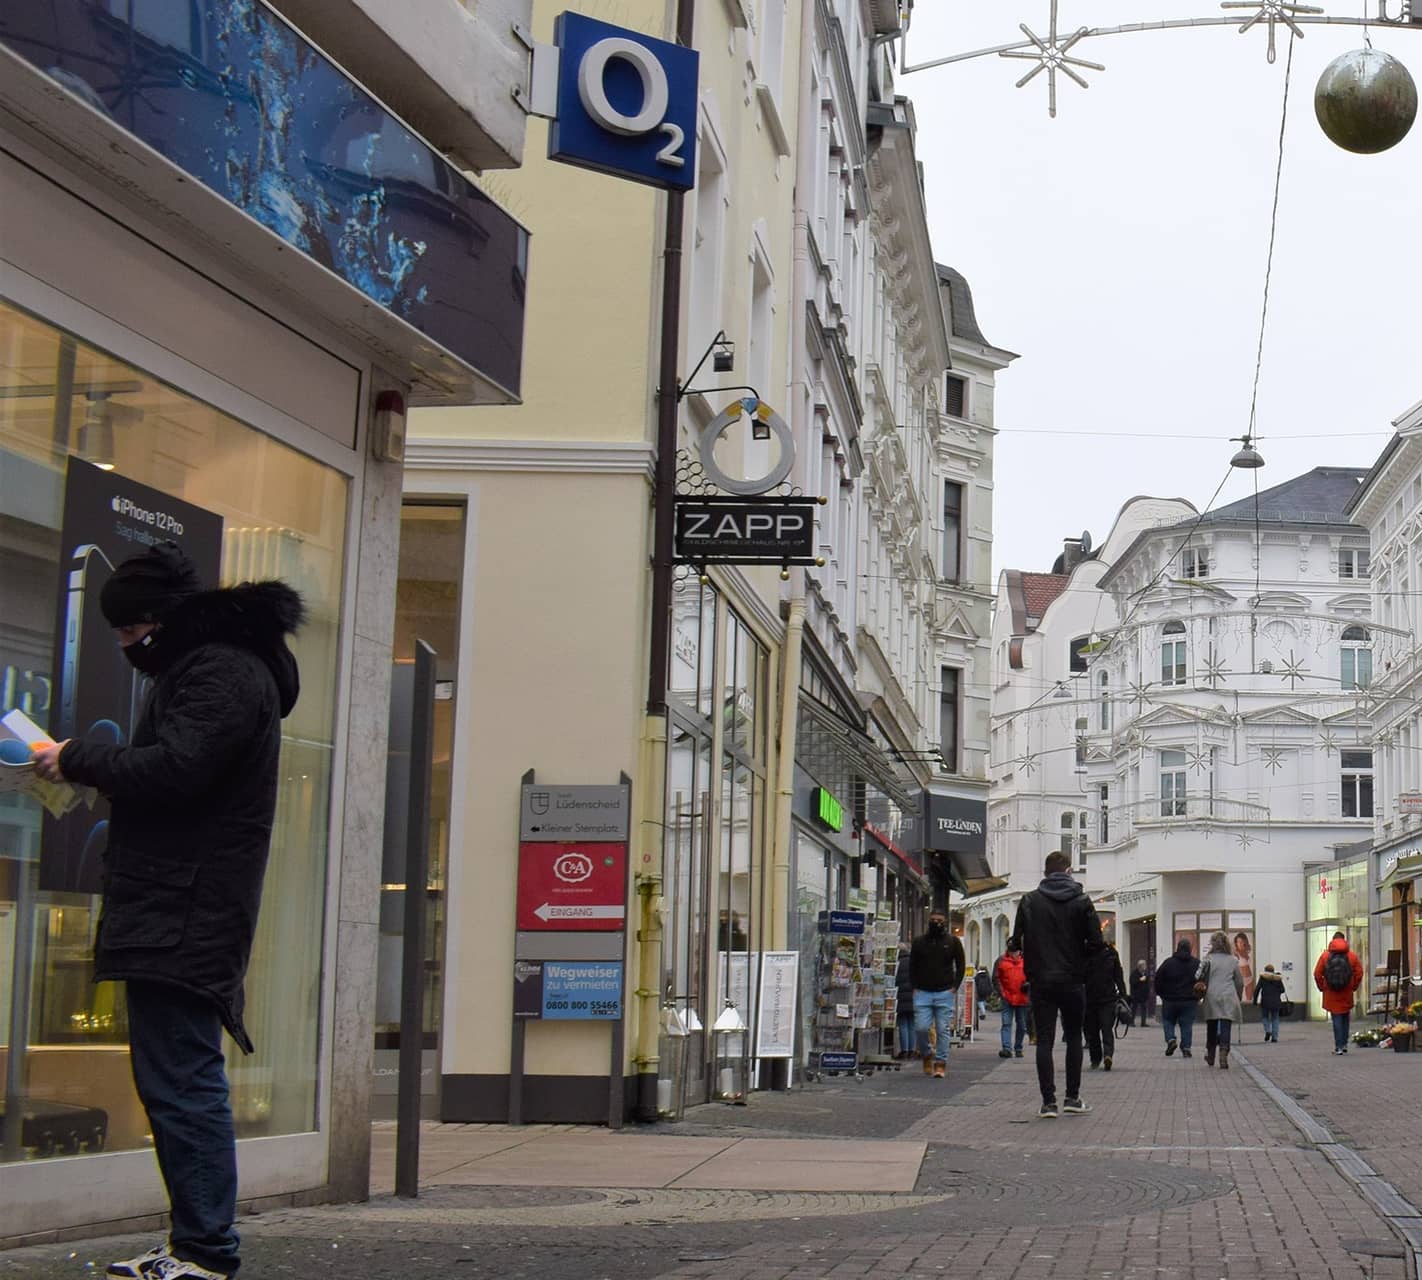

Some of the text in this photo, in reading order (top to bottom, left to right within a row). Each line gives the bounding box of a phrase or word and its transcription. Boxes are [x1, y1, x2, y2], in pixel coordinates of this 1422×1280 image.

[120, 498, 184, 535] iPhone 12 Pro
[683, 513, 804, 540] ZAPP
[540, 823, 573, 833] Kleiner
[560, 861, 586, 875] C&A
[550, 908, 593, 917] EINGANG
[547, 965, 619, 981] Wegweiser
[546, 980, 619, 991] zu vermieten
[546, 1001, 569, 1010] 0800
[571, 1001, 588, 1010] 800
